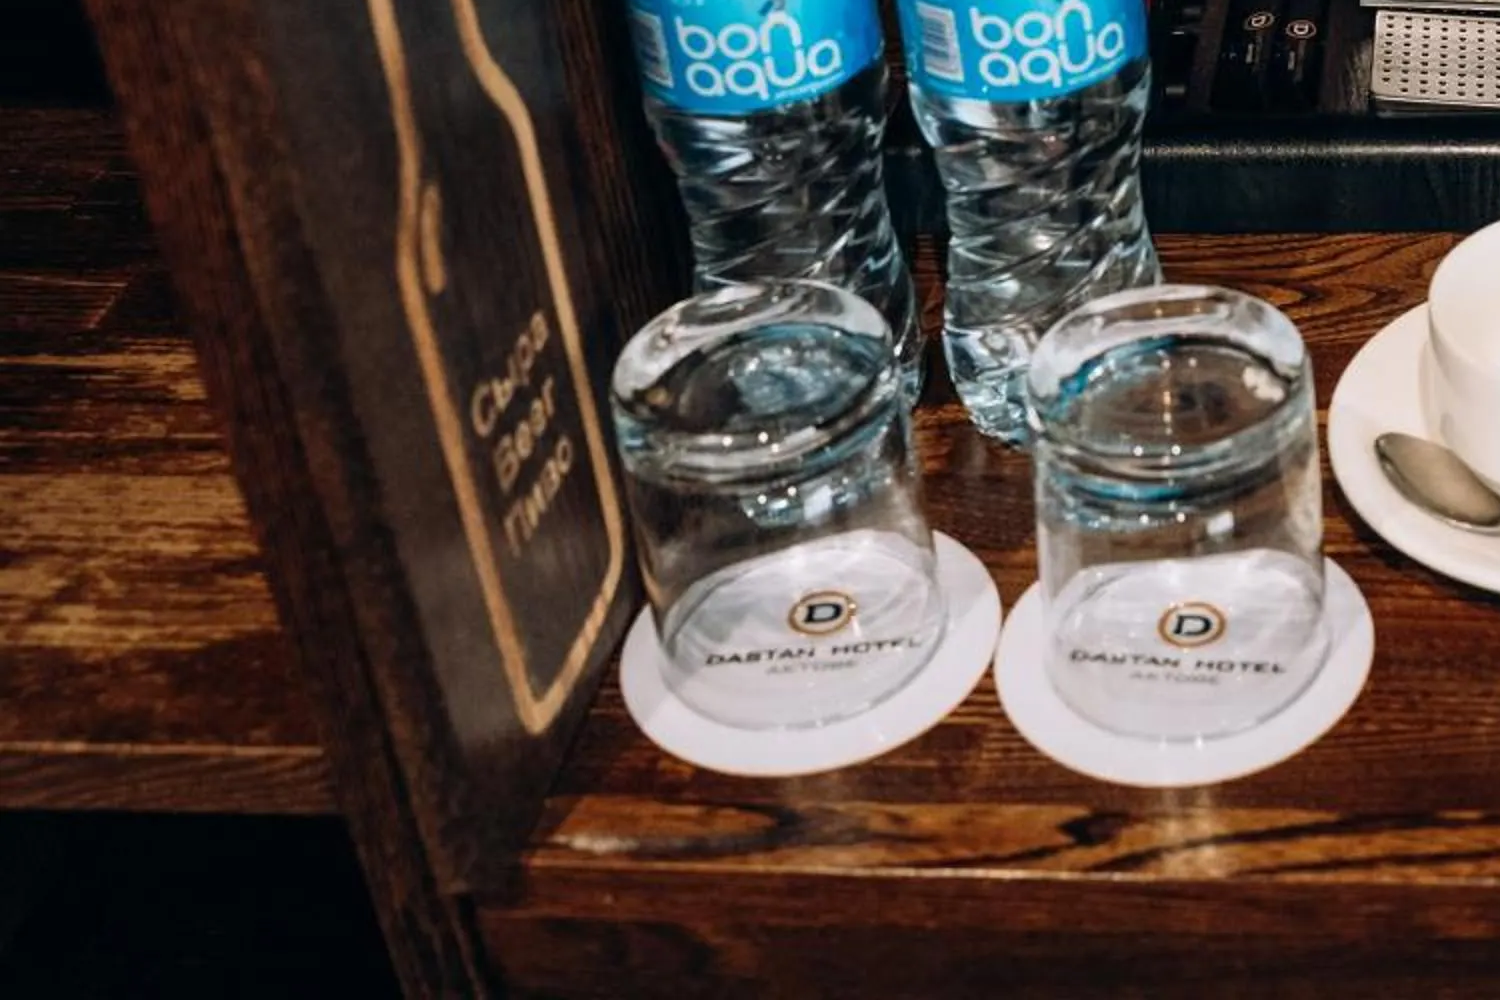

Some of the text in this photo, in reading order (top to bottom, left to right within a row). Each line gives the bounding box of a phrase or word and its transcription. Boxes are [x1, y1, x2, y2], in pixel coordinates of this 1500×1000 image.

[674, 11, 802, 61] bon
[979, 21, 1124, 88] aqua
[685, 38, 842, 101] aqua
[704, 647, 816, 667] DASTAN
[1194, 658, 1287, 675] HOTEL
